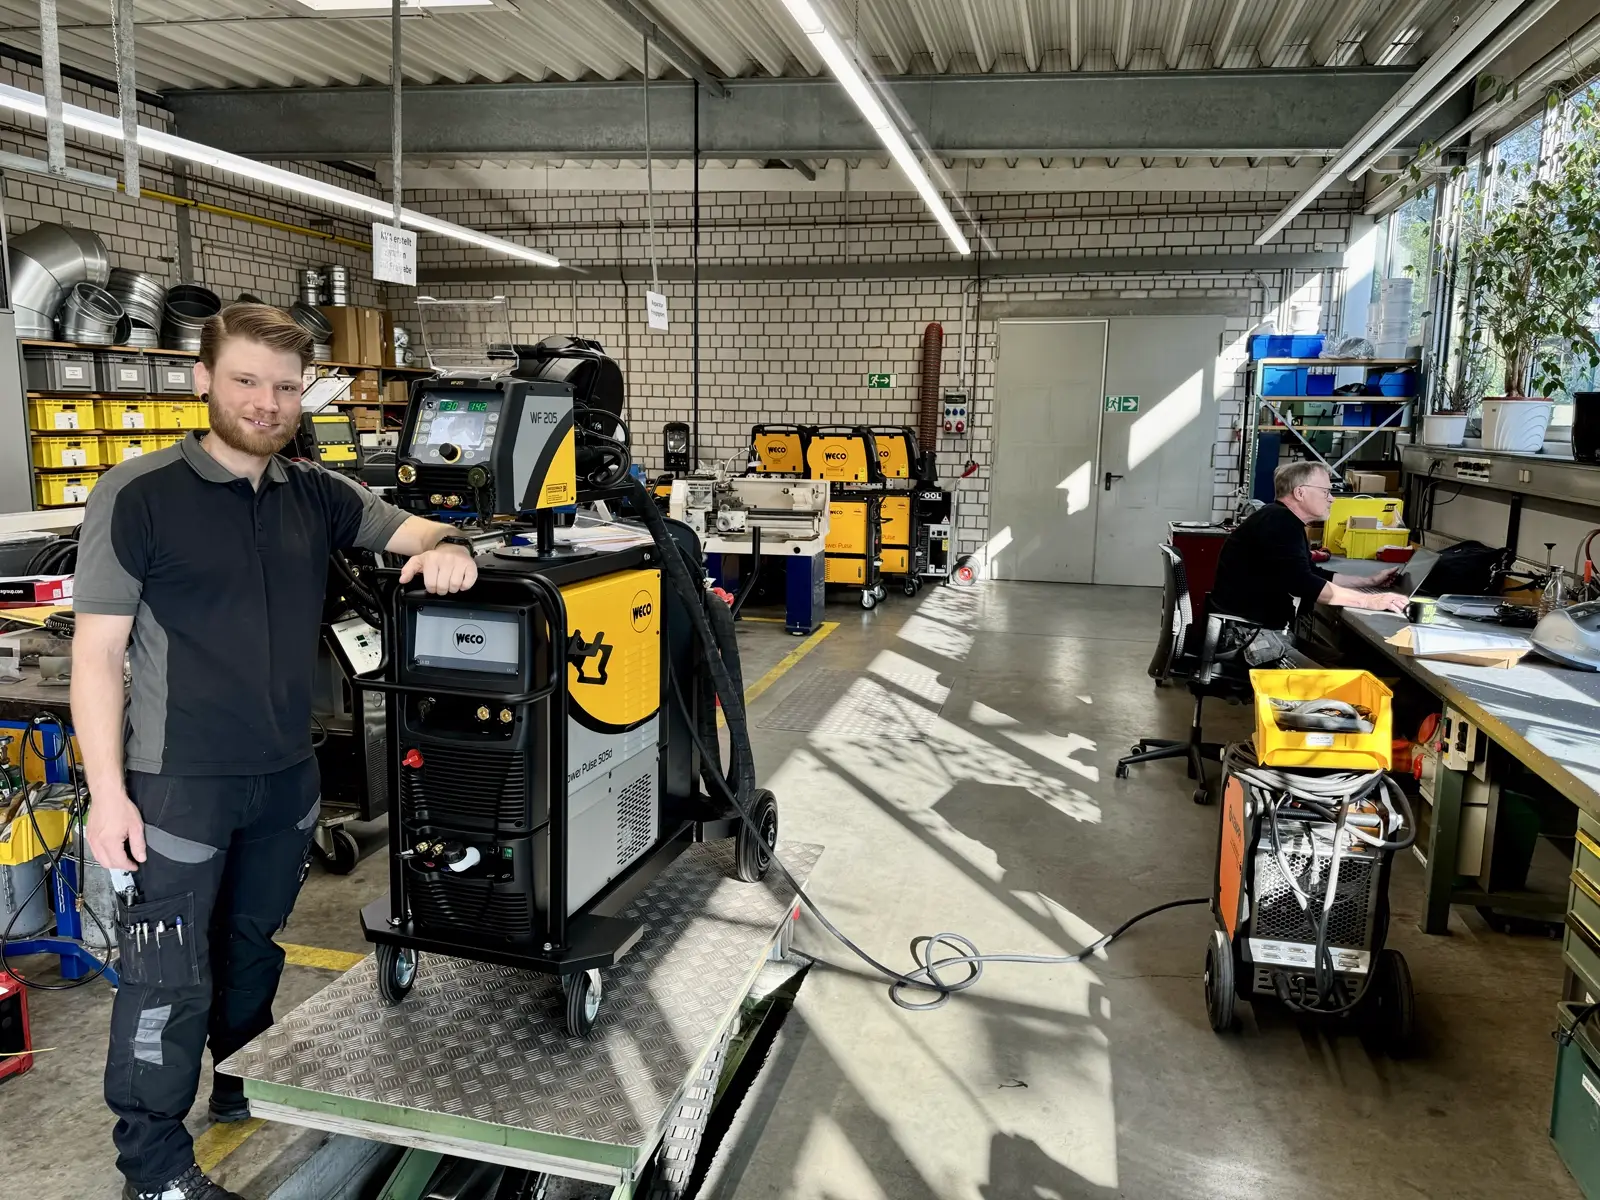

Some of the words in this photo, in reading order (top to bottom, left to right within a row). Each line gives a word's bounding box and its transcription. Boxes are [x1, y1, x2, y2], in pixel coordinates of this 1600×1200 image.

[530, 412, 543, 424] WF
[543, 411, 558, 424] 205
[767, 446, 787, 454] WECO
[825, 451, 848, 461] WECO
[632, 602, 652, 625] WECO
[456, 633, 484, 646] WECO
[567, 768, 582, 784] ower
[581, 758, 598, 775] Pulse
[598, 747, 613, 765] 505d
